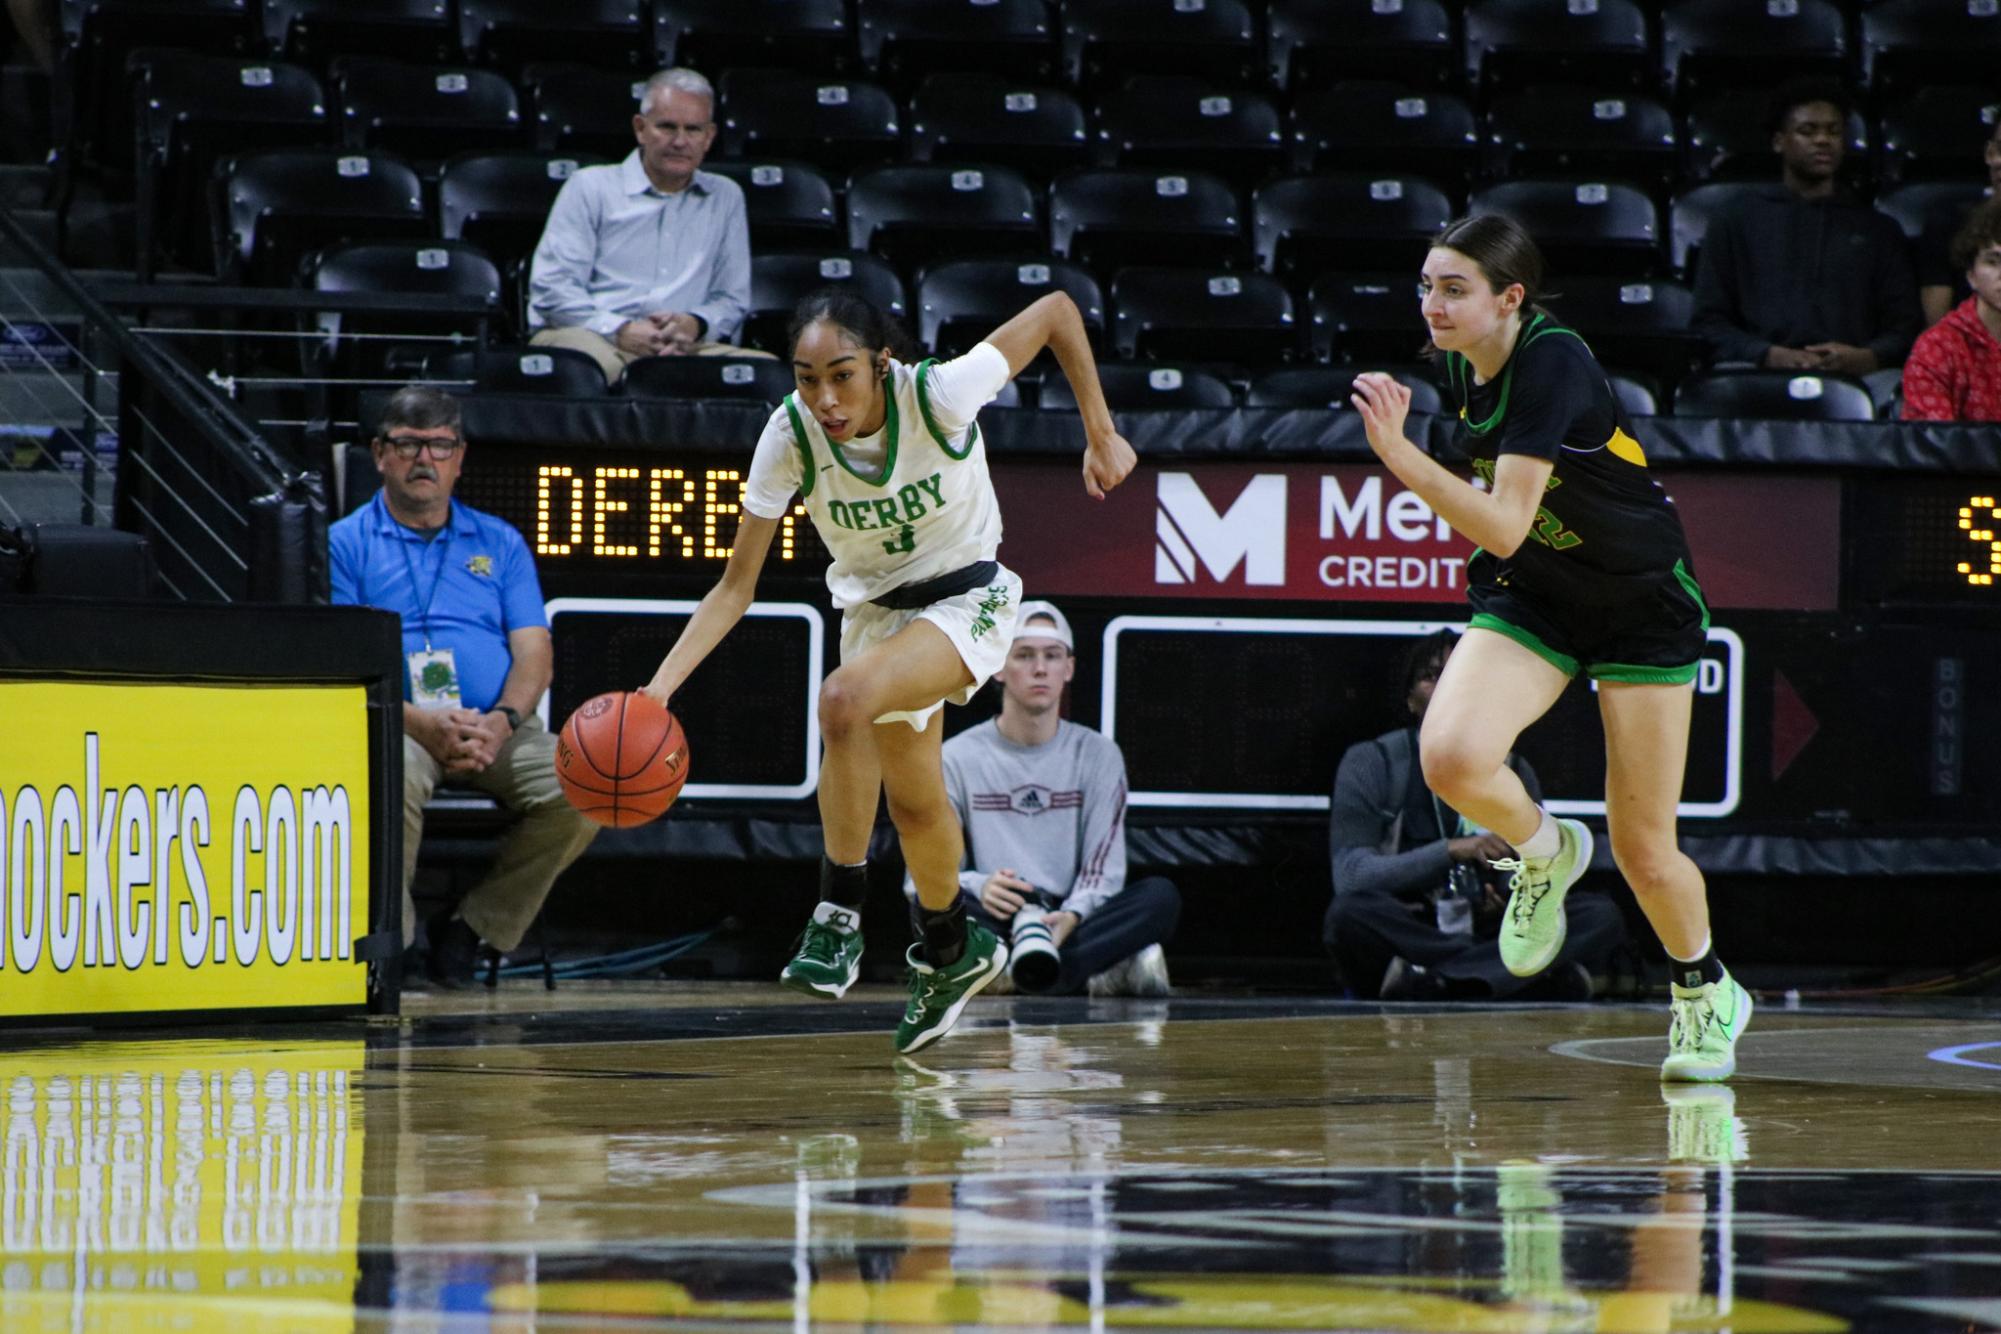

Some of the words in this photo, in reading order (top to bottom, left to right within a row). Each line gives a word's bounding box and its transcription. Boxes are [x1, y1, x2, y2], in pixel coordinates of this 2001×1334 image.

[828, 473, 946, 531] DERBY
[1319, 555, 1464, 589] CREDIT
[1938, 657, 1957, 794] BONUS
